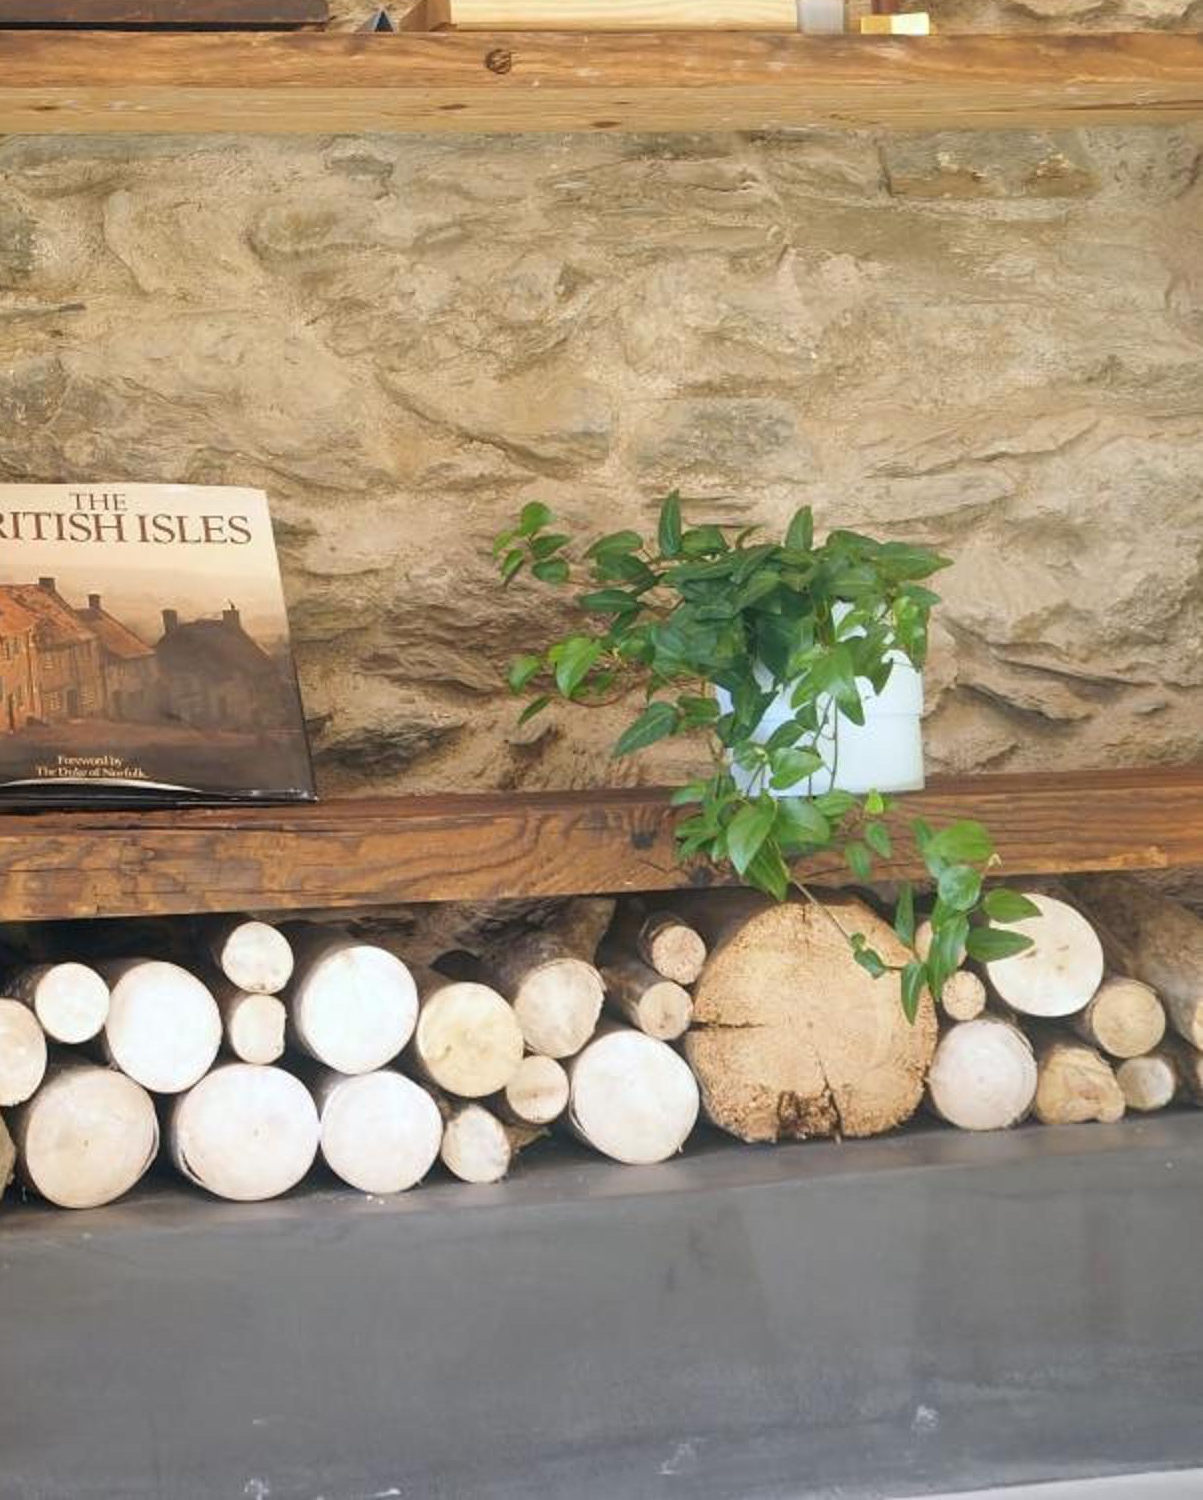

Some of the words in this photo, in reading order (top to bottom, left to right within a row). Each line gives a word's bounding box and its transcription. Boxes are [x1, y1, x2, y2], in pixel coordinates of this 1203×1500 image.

[69, 493, 128, 511] THE
[136, 513, 253, 545] ISLES
[57, 755, 108, 765] Foreword
[109, 755, 123, 767] by
[36, 765, 57, 776] The
[88, 766, 101, 777] of
